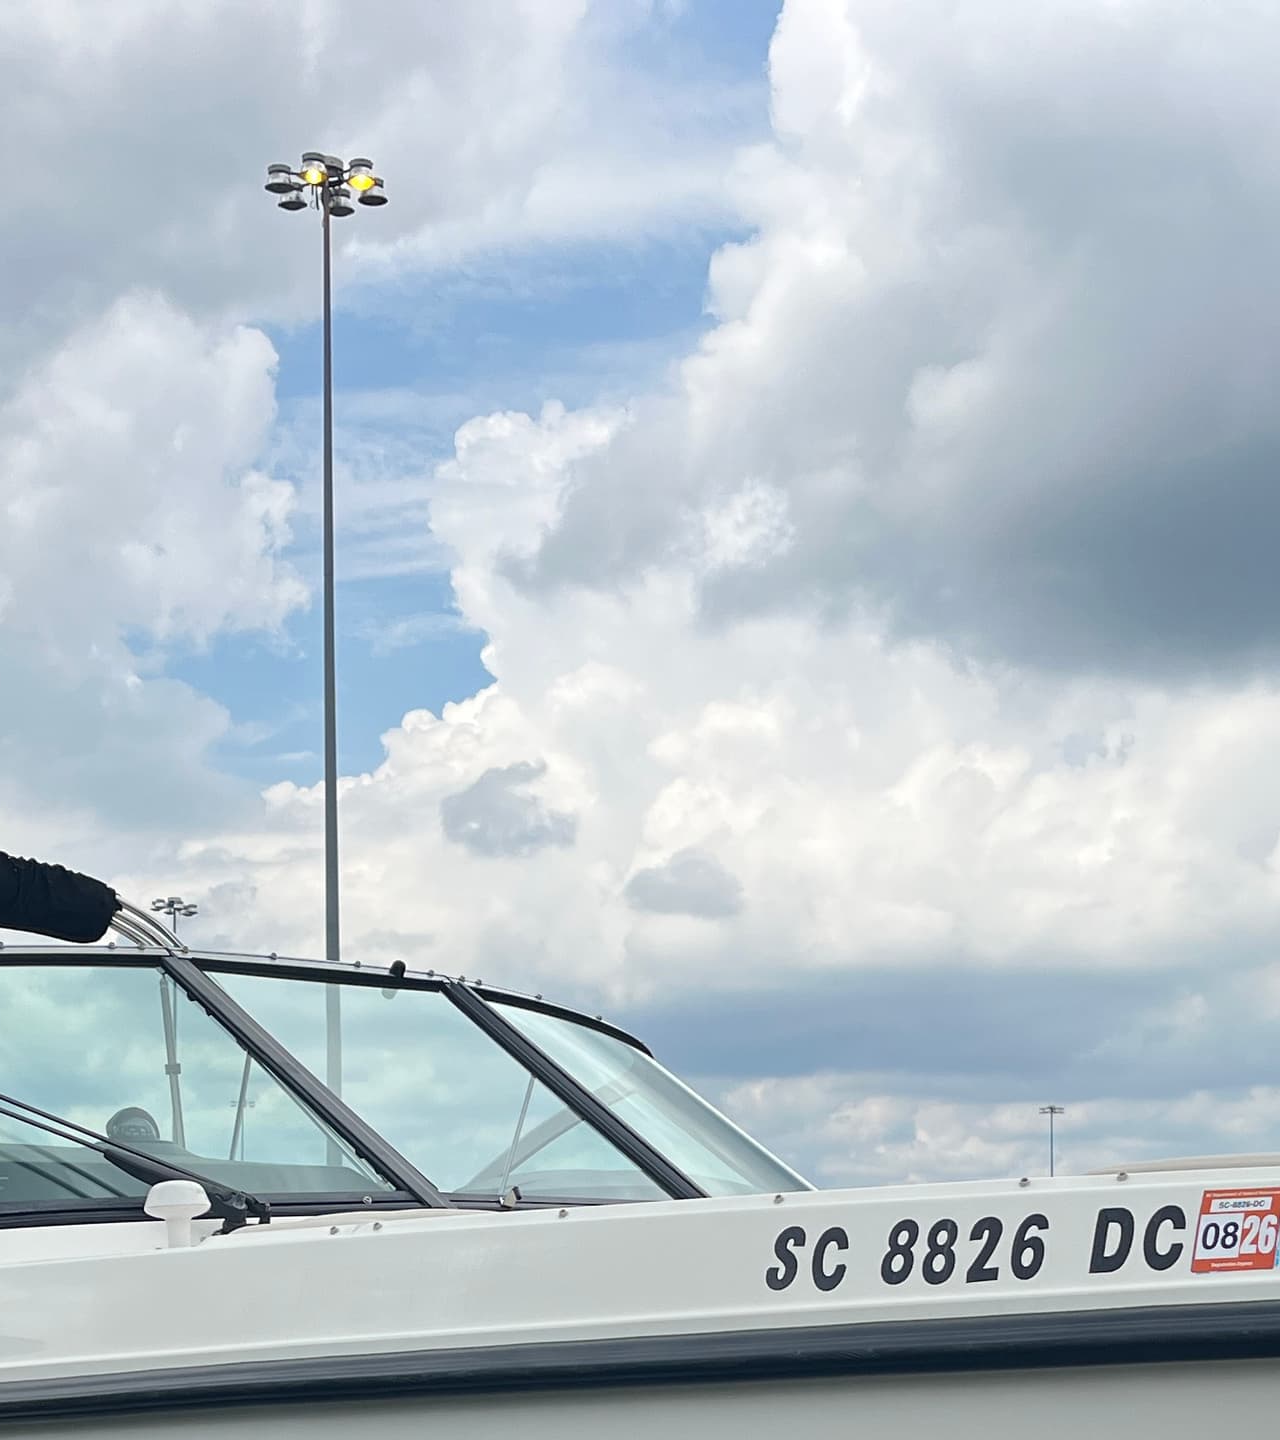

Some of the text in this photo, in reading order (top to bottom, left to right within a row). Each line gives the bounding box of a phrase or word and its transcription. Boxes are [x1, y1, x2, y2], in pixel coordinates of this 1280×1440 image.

[765, 1204, 1187, 1291] SC 8826 DC
[1201, 1214, 1278, 1254] 08 26
